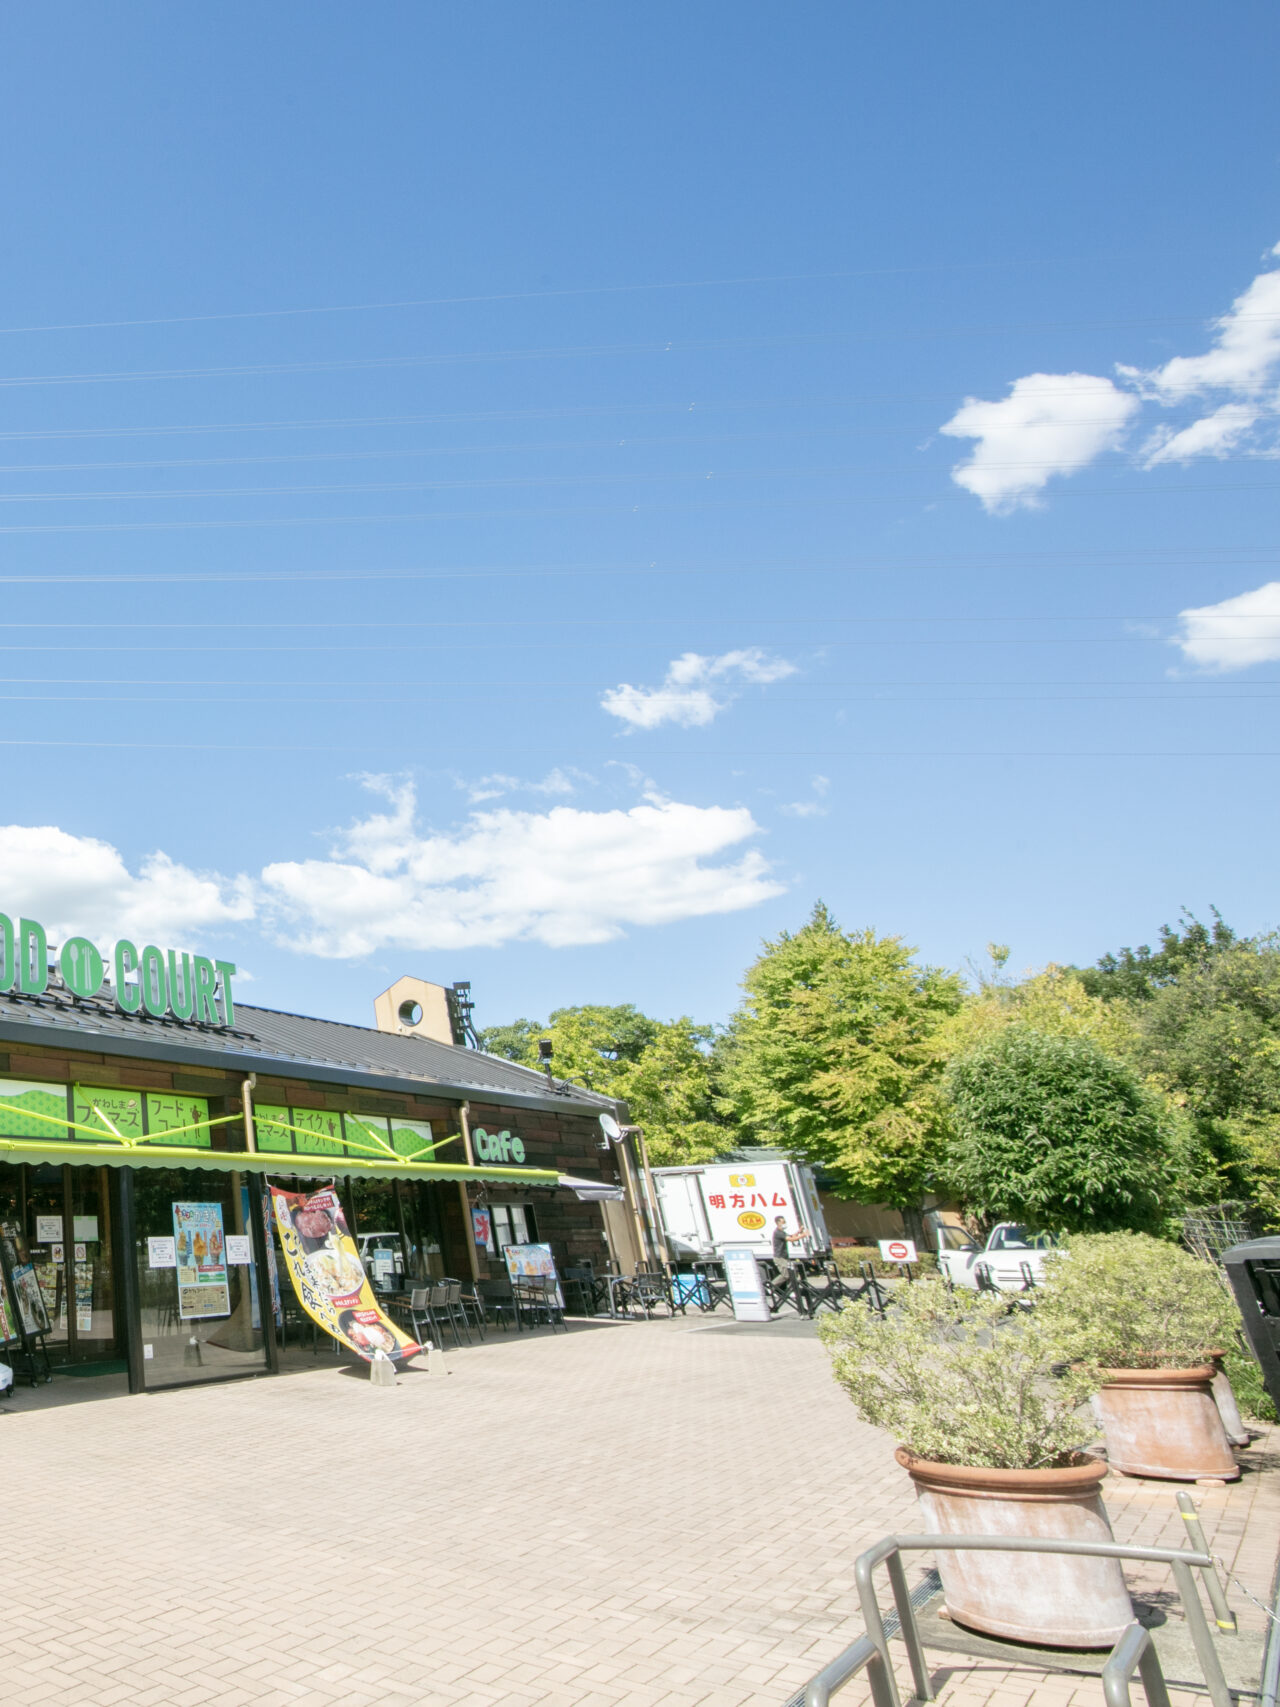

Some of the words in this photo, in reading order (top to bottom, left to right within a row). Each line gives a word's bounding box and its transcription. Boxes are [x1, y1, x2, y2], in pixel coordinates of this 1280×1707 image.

[111, 938, 237, 1027] COURT
[92, 1098, 127, 1110] かわしま
[151, 1100, 184, 1118] フード
[76, 1105, 140, 1128] ファマーズ
[296, 1112, 323, 1130] テイク
[158, 1119, 187, 1138] コート
[708, 1192, 788, 1209] 明方ハム
